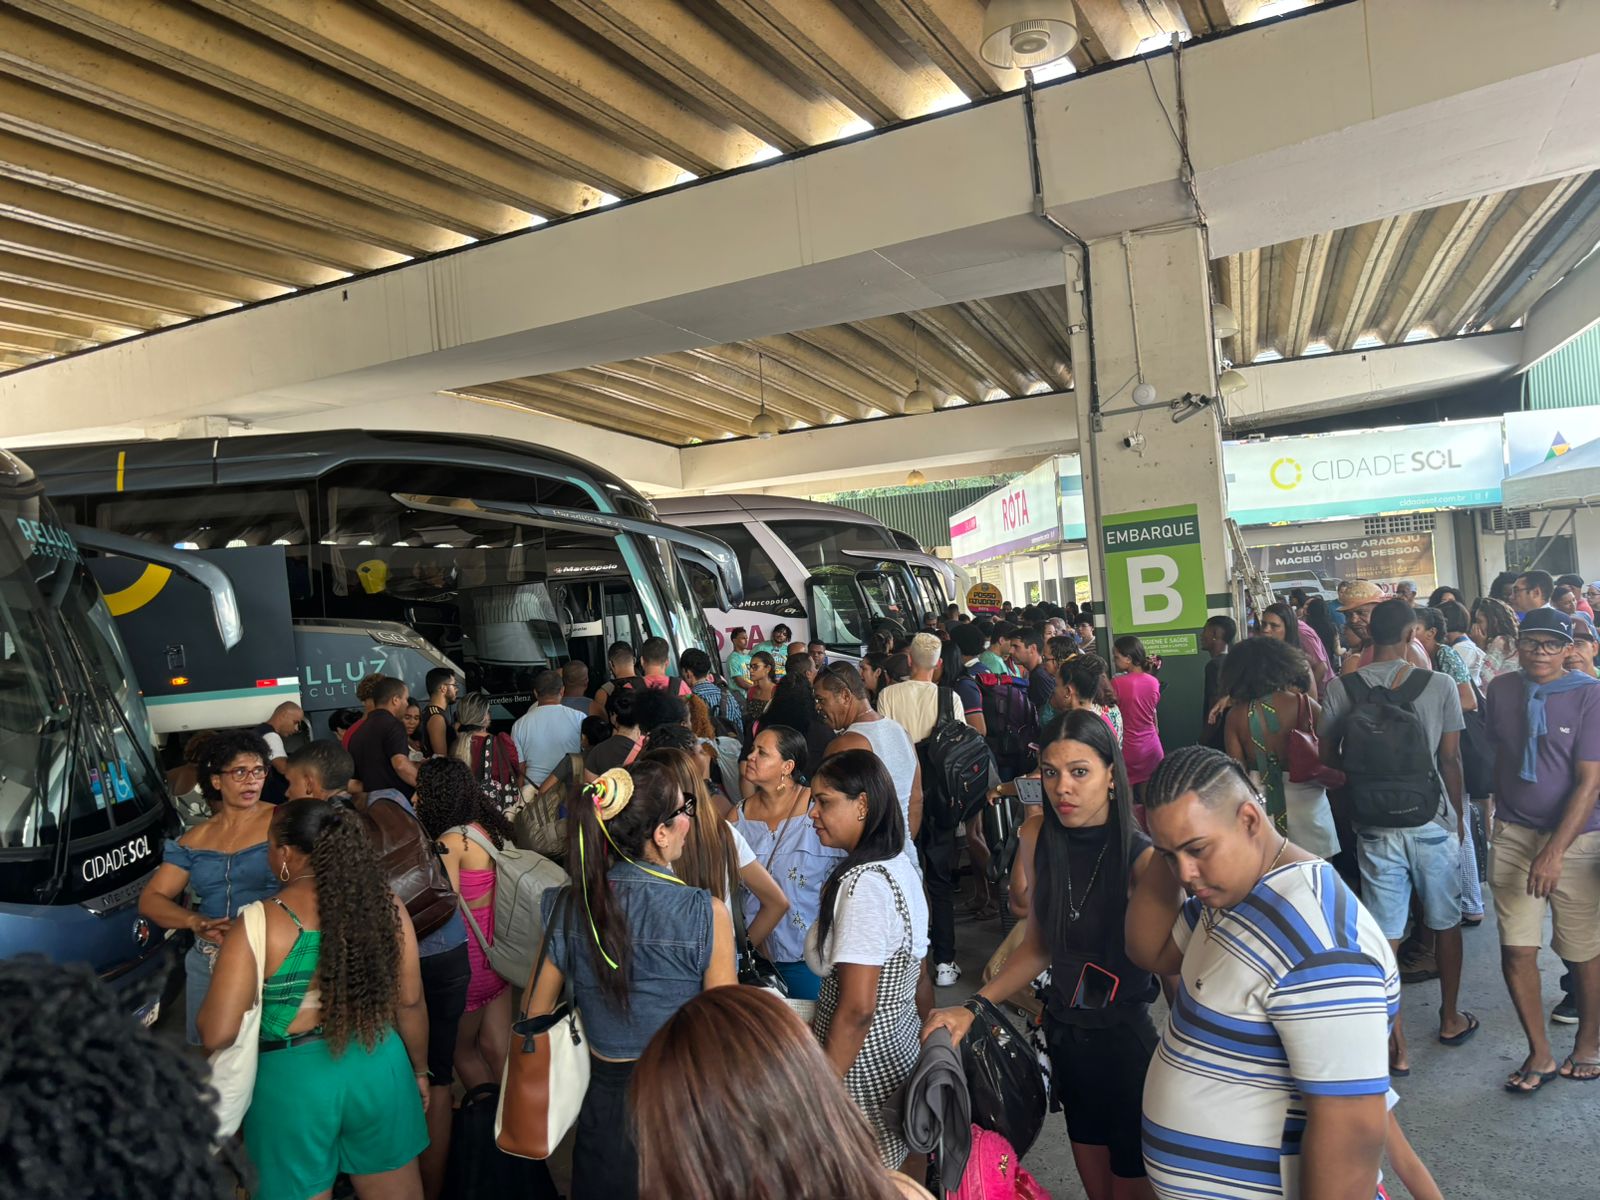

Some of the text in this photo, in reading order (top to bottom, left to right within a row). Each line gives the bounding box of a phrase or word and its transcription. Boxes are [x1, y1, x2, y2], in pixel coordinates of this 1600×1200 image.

[1312, 449, 1463, 482] CIDADE SOL
[1002, 488, 1030, 532] ROTA
[1106, 522, 1195, 545] EMBARQUE
[1286, 534, 1421, 554] JUAZEIRO ARACAJU
[1275, 545, 1421, 566] MACEIÓ JOÃO PESSOA
[562, 563, 618, 573] Marcopolo
[1125, 553, 1184, 626] B
[744, 598, 789, 607] Marcopolo
[82, 834, 152, 882] CIDADE SOL
